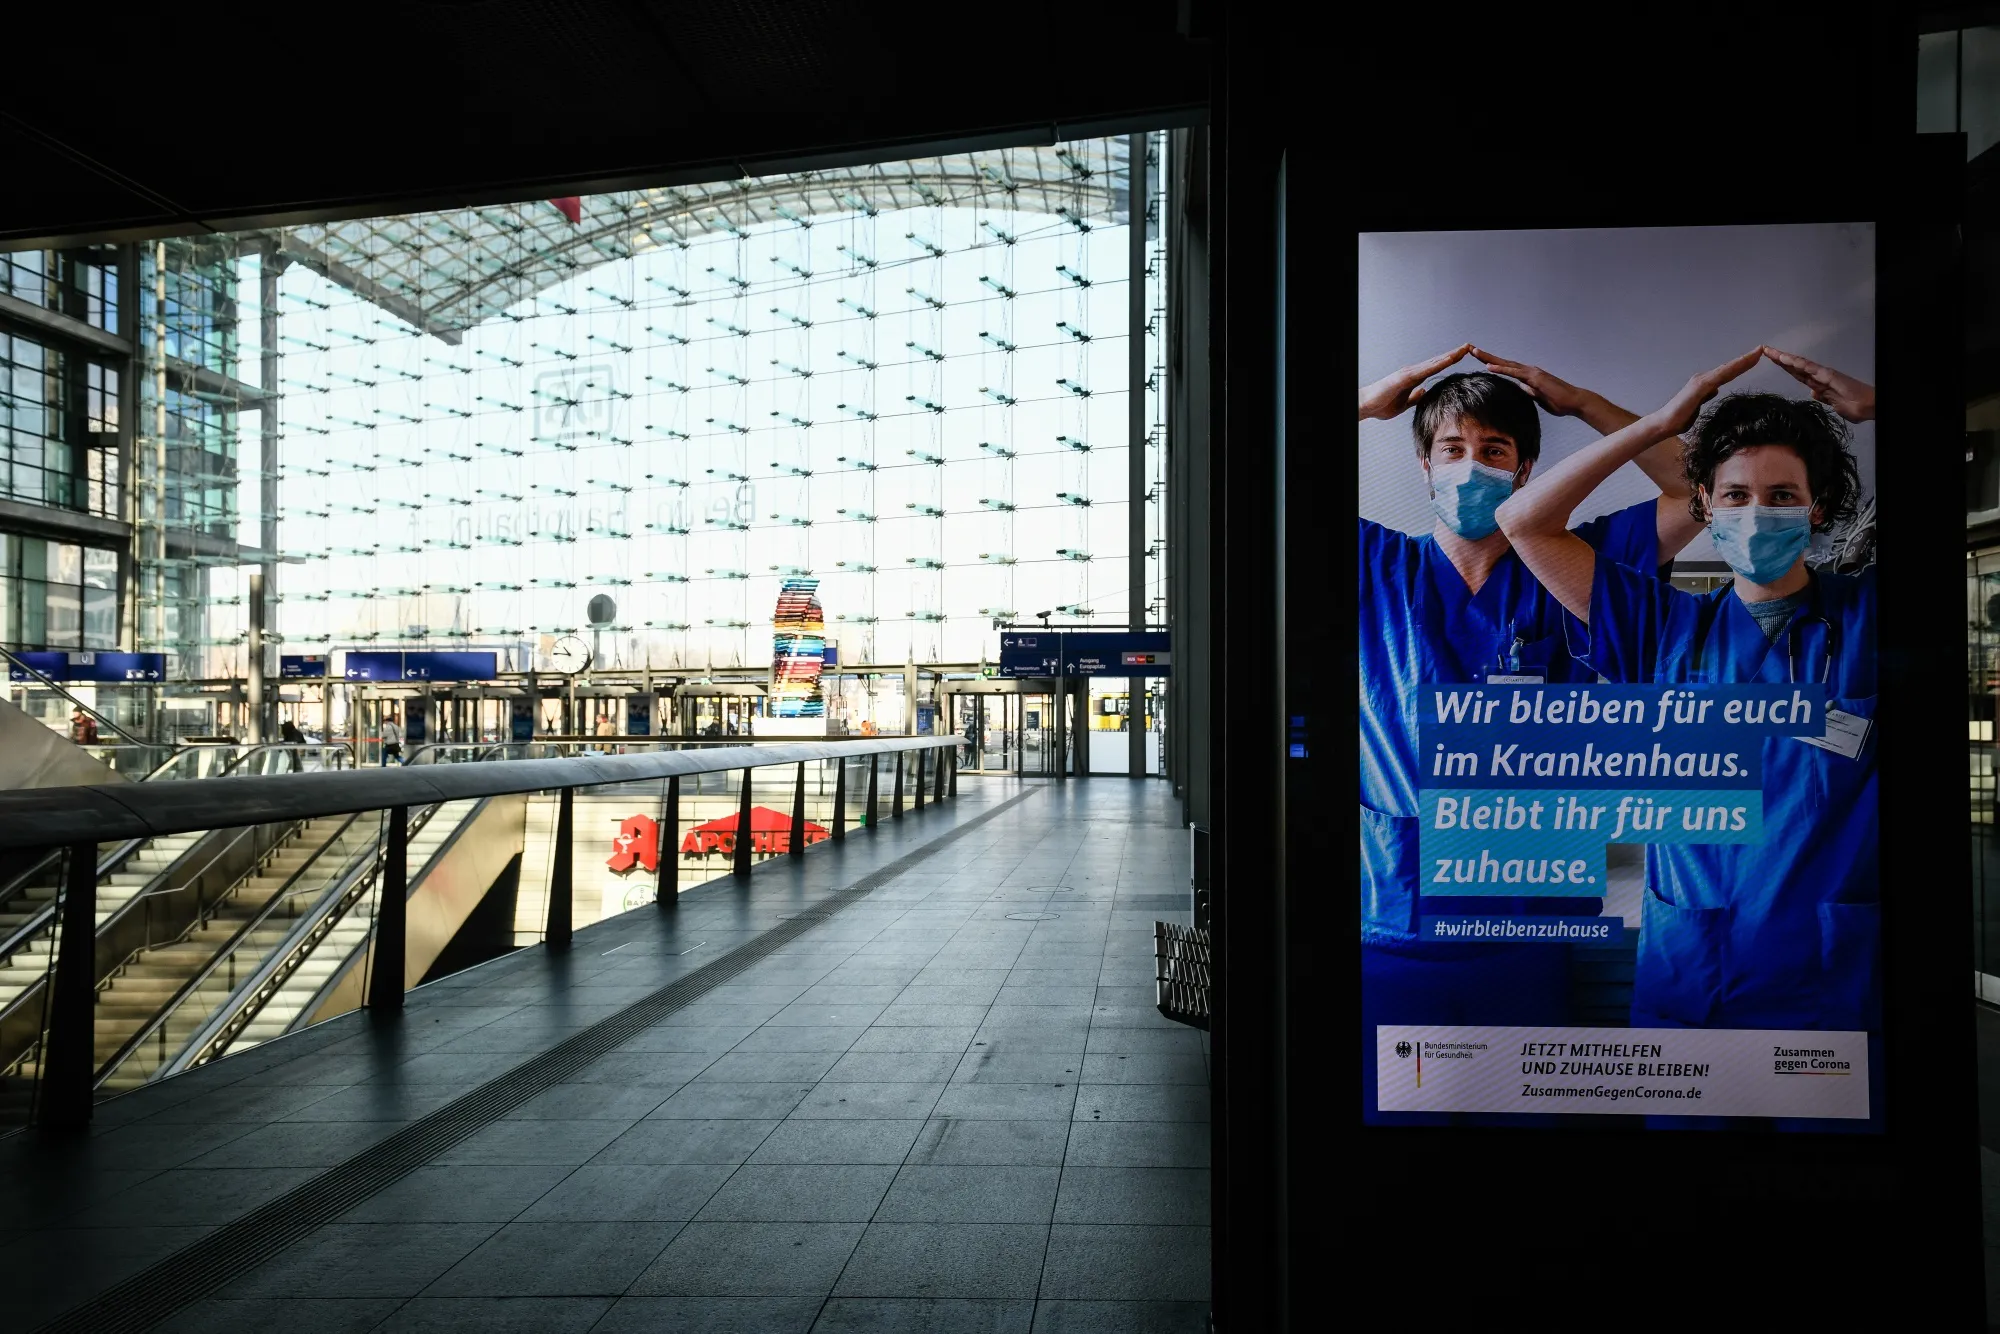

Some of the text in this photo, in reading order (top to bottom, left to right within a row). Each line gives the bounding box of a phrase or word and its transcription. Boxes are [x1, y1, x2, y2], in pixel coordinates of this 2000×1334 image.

[1436, 691, 1811, 733] Wir bleiben für euch
[1434, 744, 1748, 777] im Krankenhaus.
[1435, 797, 1747, 839] Bleibt ihr für uns
[1434, 850, 1596, 884] zuhause.
[1434, 920, 1609, 938] #wirbleibenzuhause
[1424, 1042, 1488, 1051] Bundesministerium
[1519, 1043, 1662, 1058] JETZT MITHELFEN
[1773, 1047, 1835, 1058] Zusammen
[1424, 1051, 1473, 1060] für Gesundheit
[1521, 1061, 1710, 1078] UND ZUHAUSE BLEIBEN!
[1774, 1058, 1851, 1072] gegen Corona
[1521, 1084, 1702, 1102] ZusammenGegenCorona.de
